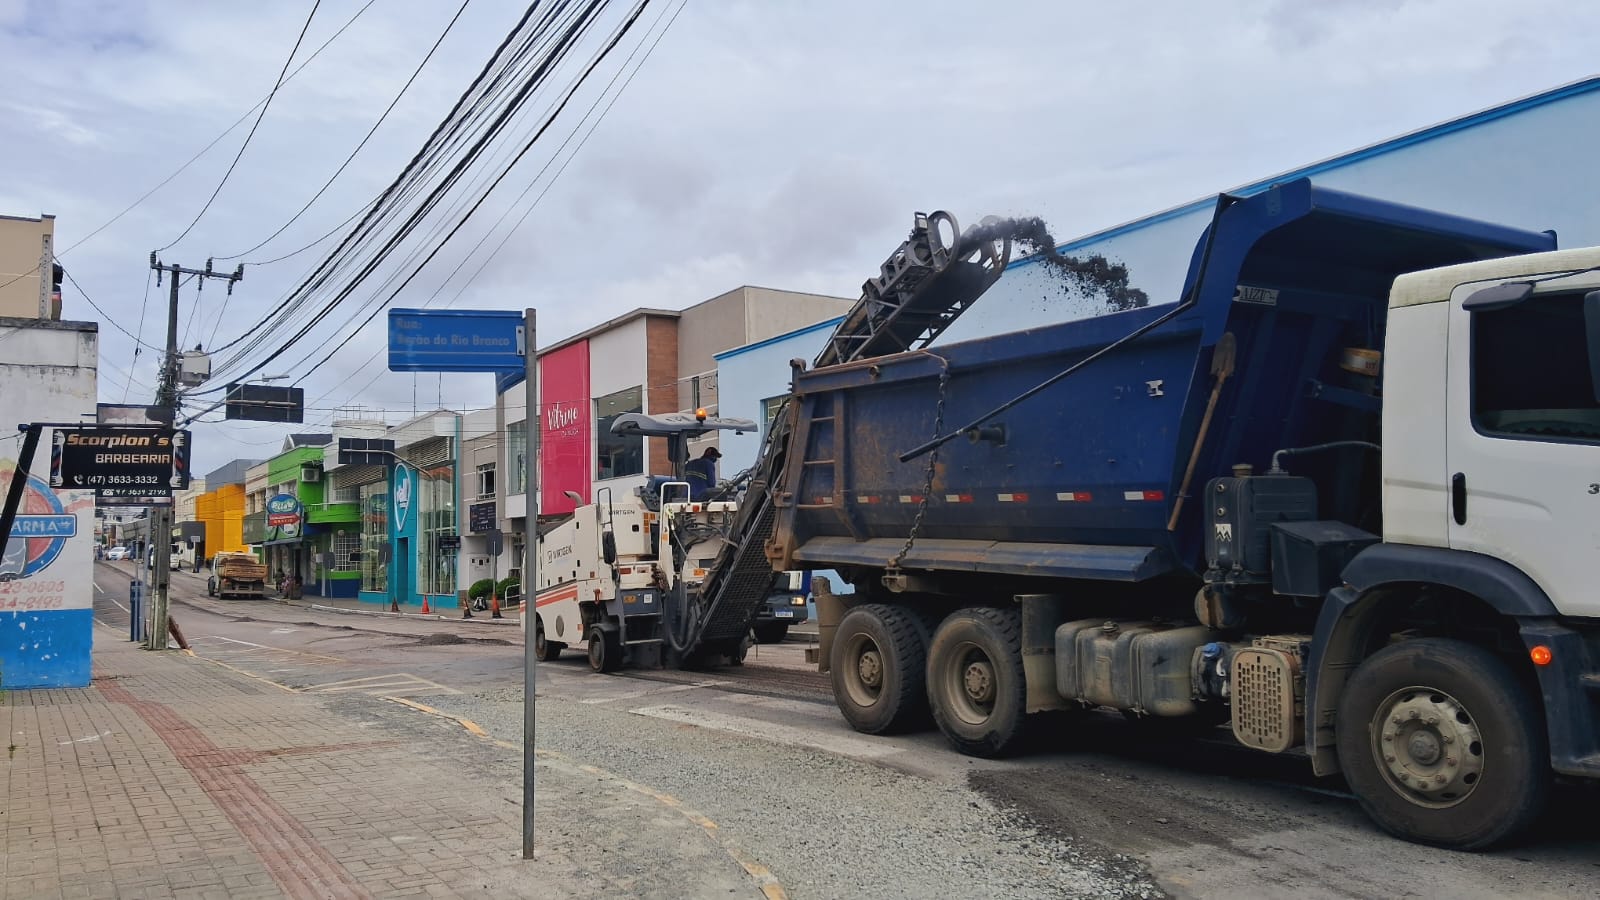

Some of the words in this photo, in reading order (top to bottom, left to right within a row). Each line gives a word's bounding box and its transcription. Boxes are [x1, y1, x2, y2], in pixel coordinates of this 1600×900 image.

[433, 335, 447, 345] do
[452, 335, 469, 345] Rio
[473, 336, 510, 346] Branco
[95, 453, 171, 464] BARBEARIA
[87, 475, 106, 485] (47)
[108, 476, 159, 484] 3633-3332
[11, 520, 59, 532] ARMA
